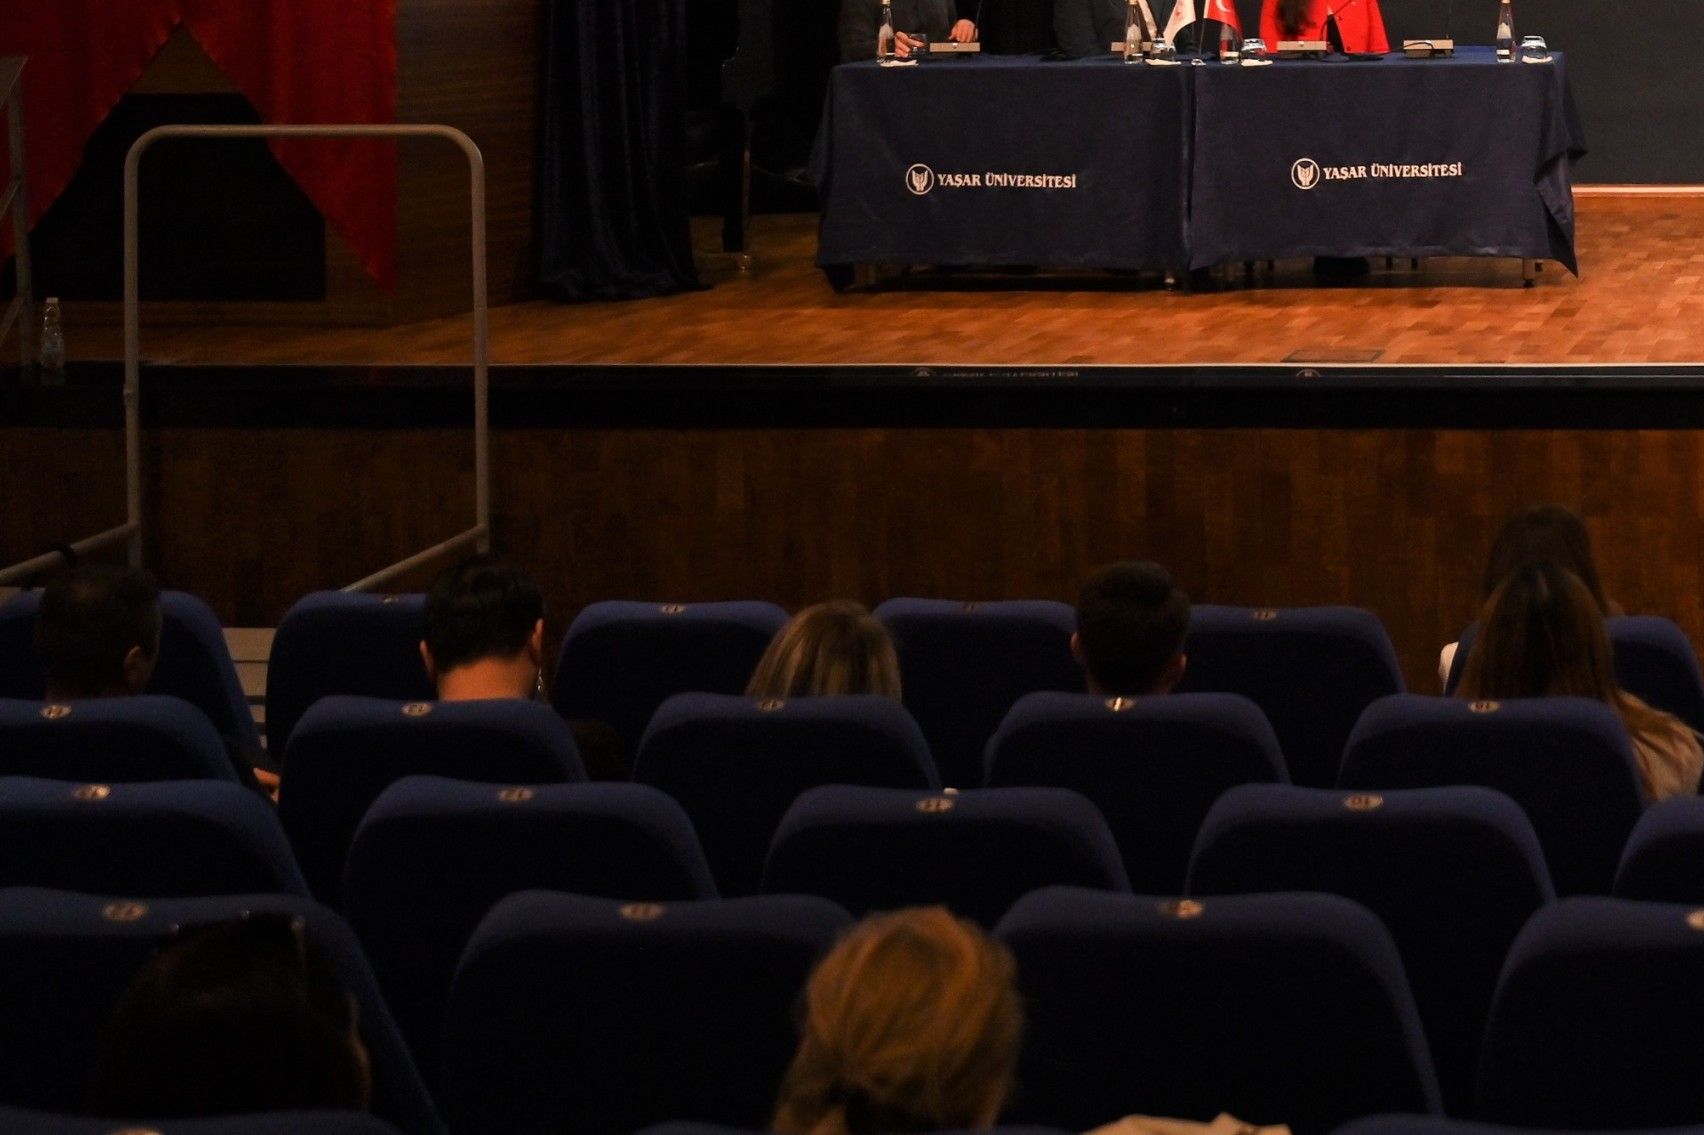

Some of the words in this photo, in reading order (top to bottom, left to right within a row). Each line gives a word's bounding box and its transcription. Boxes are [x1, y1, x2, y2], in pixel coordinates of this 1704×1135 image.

[1323, 165, 1367, 180] YAŞAR
[1371, 162, 1462, 178] ÜNİVERSİTESİ
[937, 174, 981, 187] YAŞAR
[985, 172, 1076, 188] ÜNİVERSİTESİ
